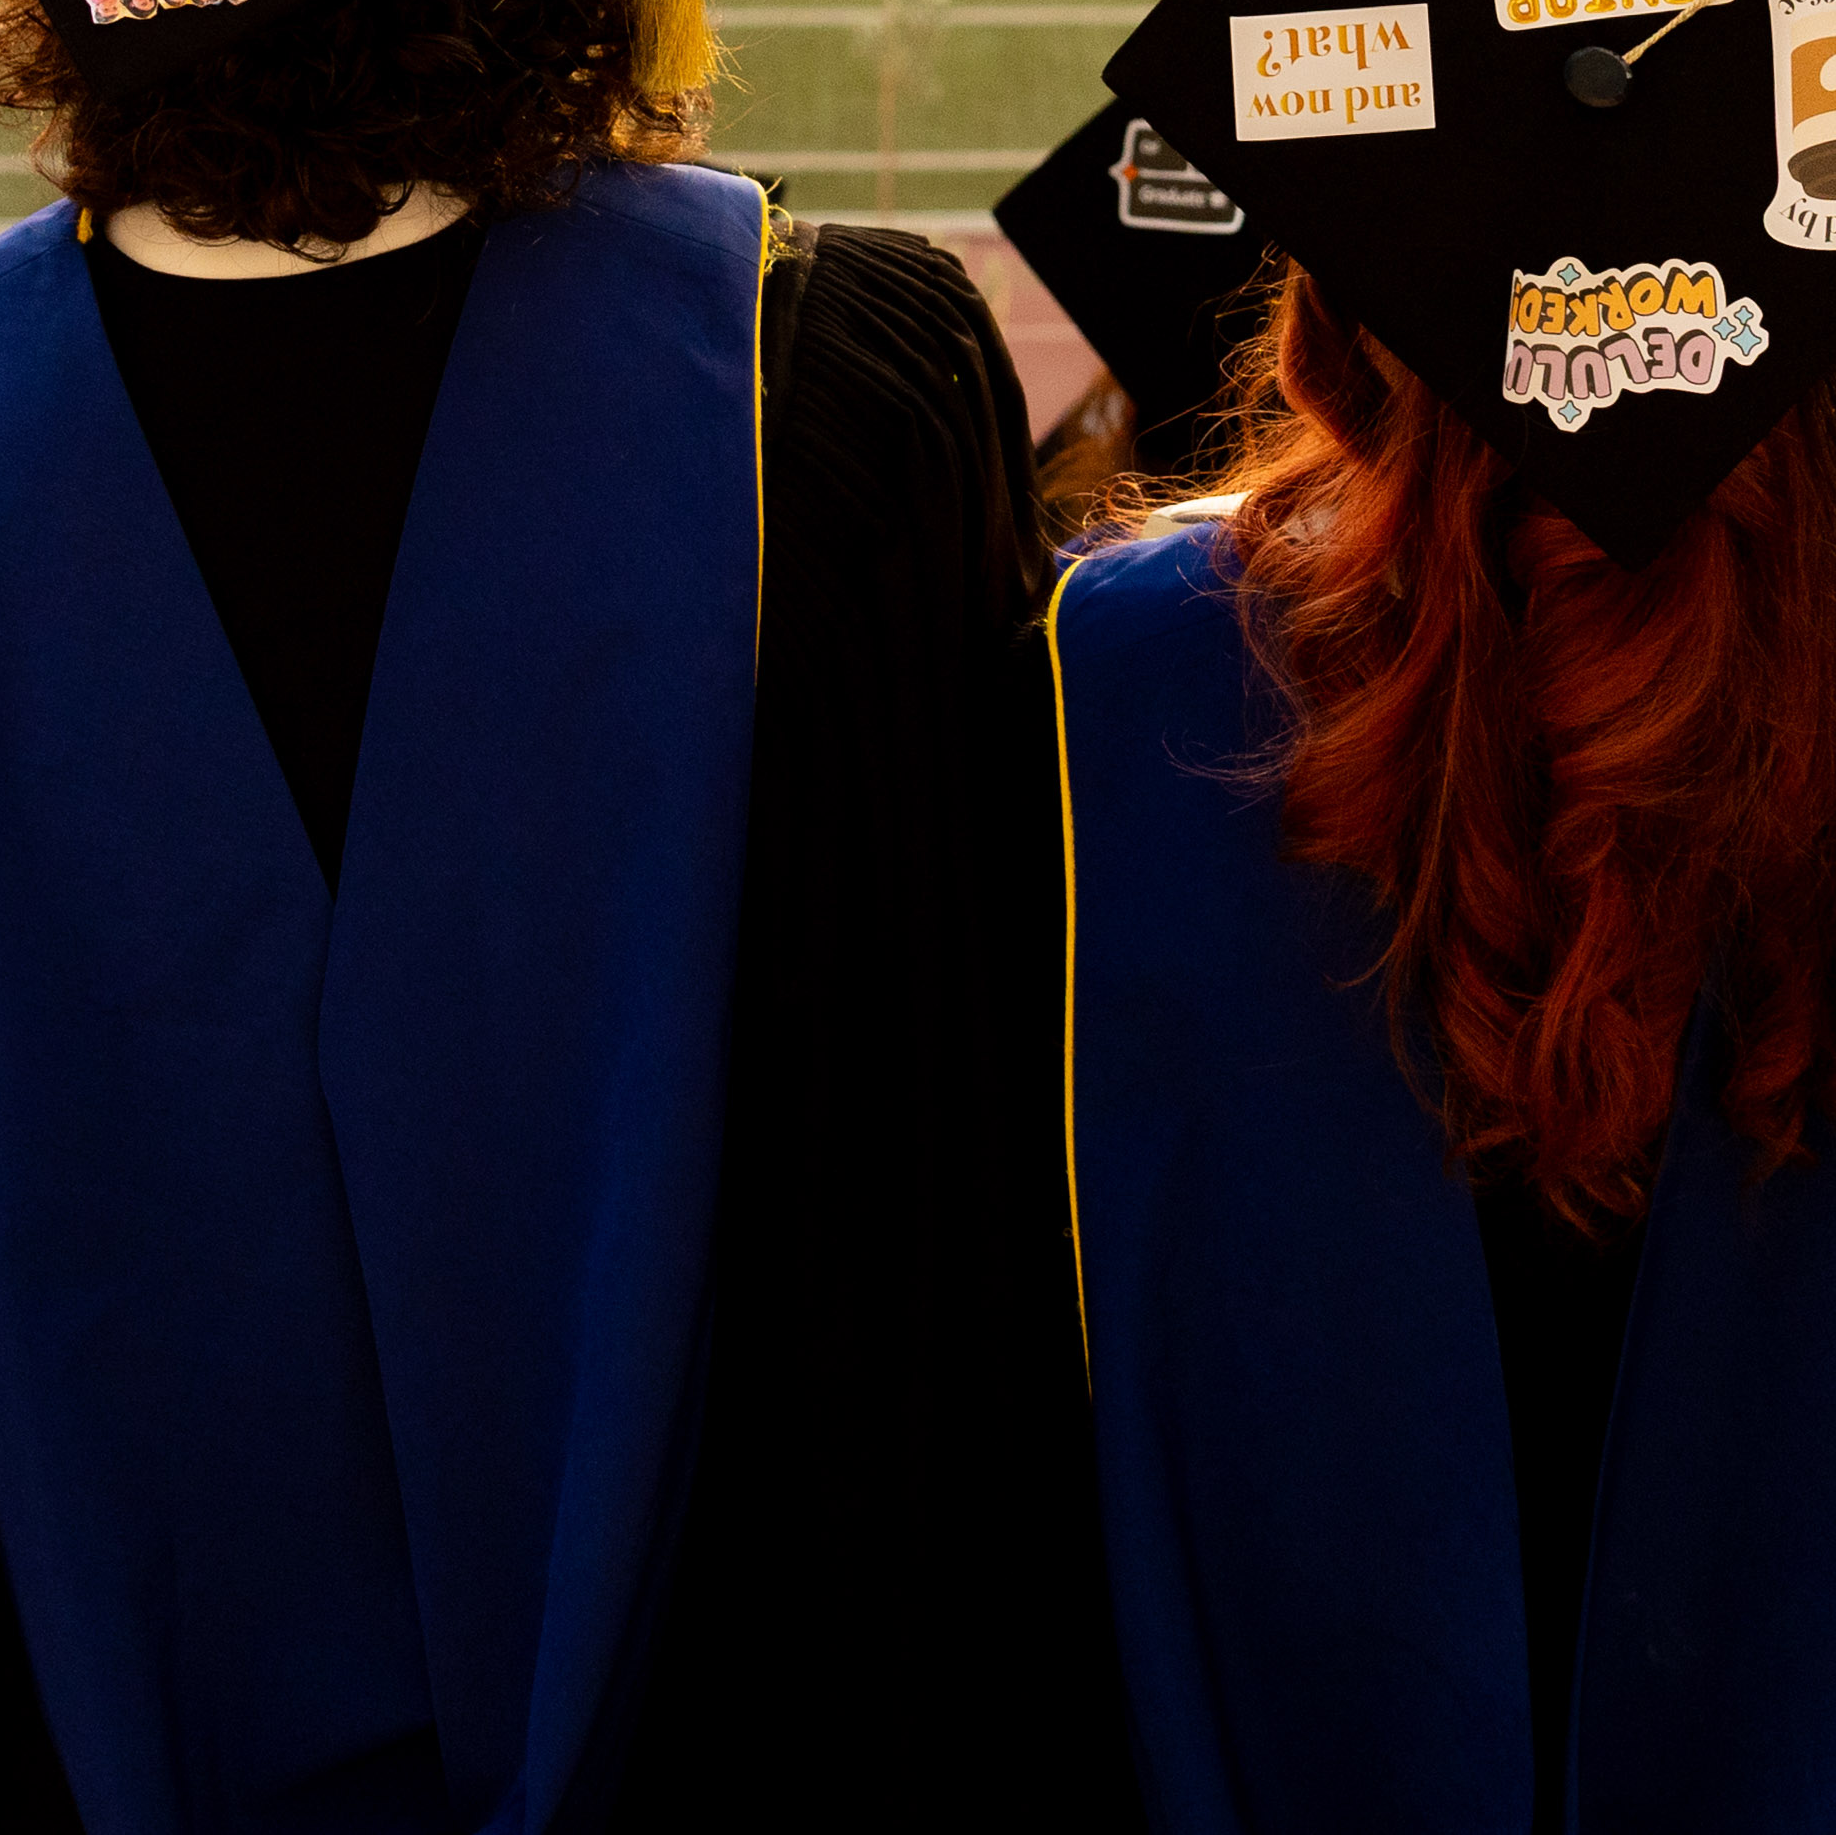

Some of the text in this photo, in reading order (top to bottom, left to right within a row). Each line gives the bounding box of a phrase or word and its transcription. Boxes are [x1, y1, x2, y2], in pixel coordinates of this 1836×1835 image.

[1256, 19, 1413, 78] what?
[1246, 82, 1421, 125] and now
[1779, 197, 1818, 240] by
[1510, 266, 1718, 337] WORKED!
[1505, 326, 1716, 400] DELULU
